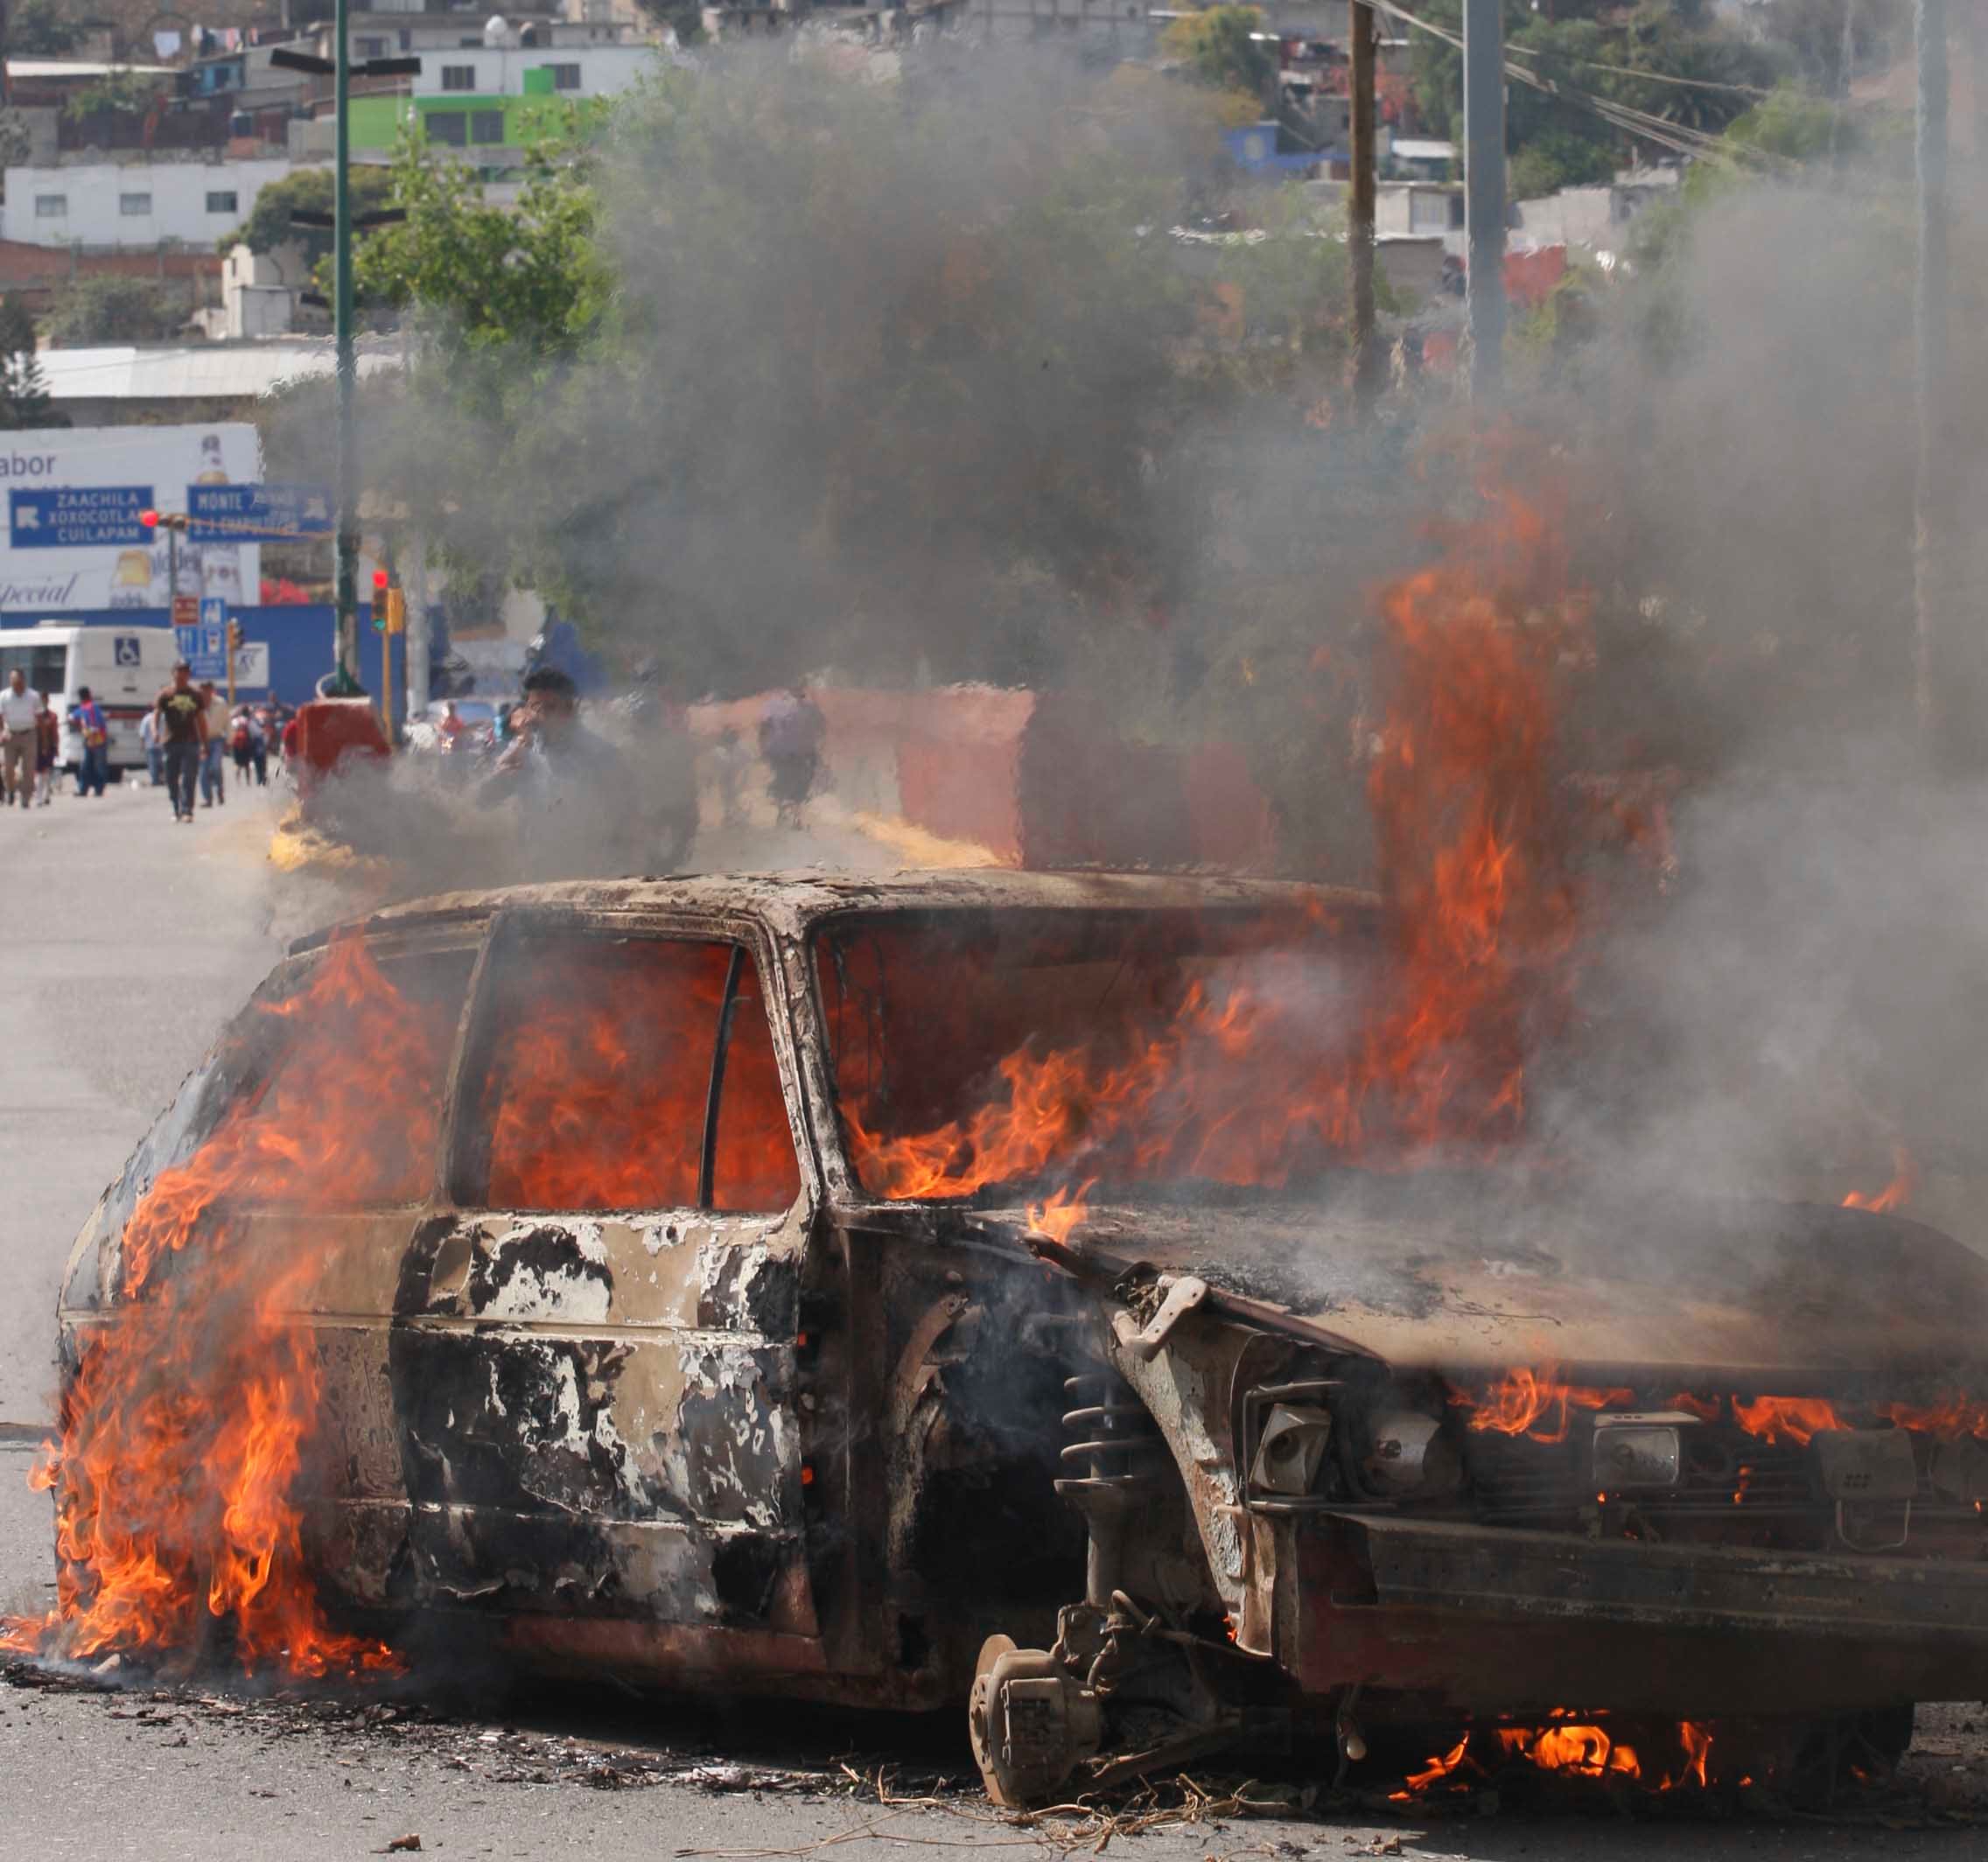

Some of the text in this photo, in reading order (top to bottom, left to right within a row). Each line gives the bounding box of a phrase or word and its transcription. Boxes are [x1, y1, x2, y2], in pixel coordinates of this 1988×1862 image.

[0, 450, 56, 477] abor
[57, 492, 138, 508] ZAACHILA
[48, 508, 141, 525] XOXOCOTLA
[58, 527, 139, 542] CUILAPAM
